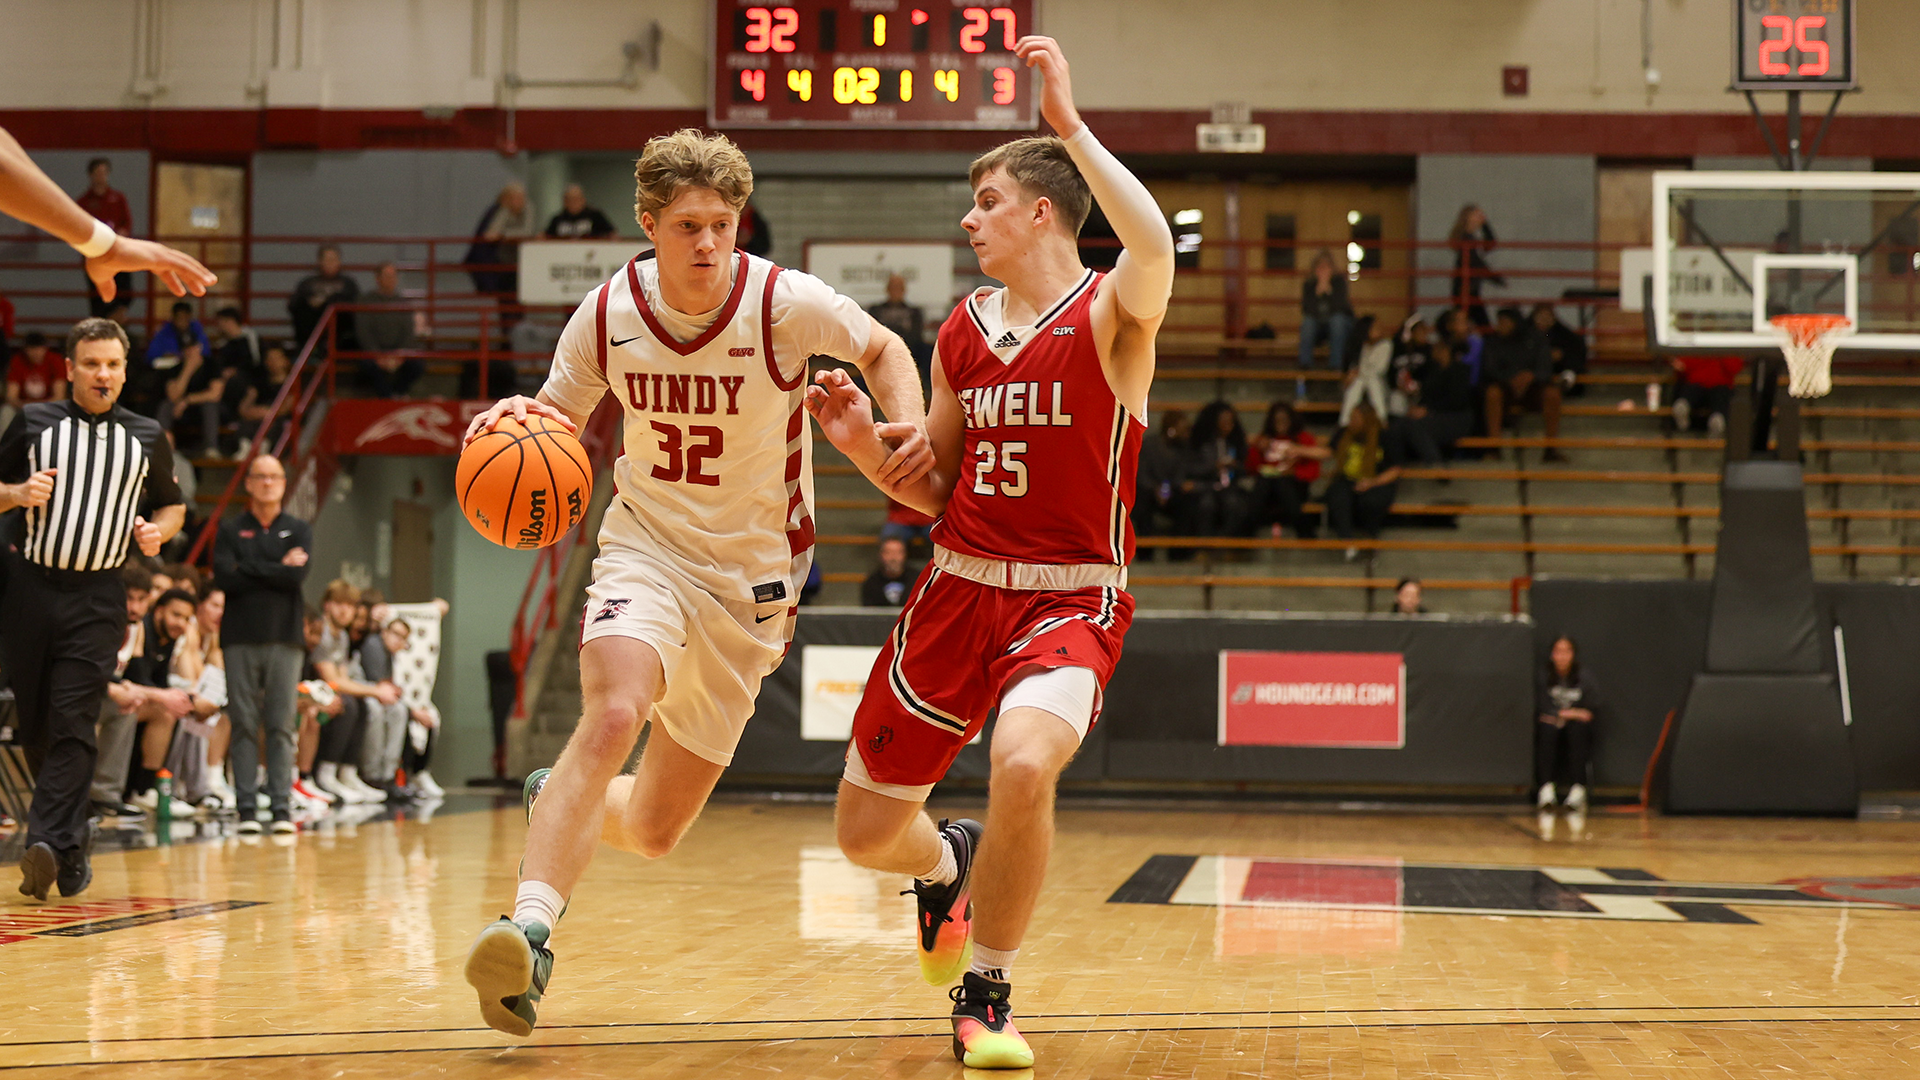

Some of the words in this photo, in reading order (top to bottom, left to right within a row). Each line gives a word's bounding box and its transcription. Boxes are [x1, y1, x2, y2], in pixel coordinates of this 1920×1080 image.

[745, 7, 799, 52] 32
[873, 13, 887, 47] 1
[959, 7, 1017, 53] 27
[1759, 15, 1830, 76] 25
[740, 69, 766, 102] 4
[787, 69, 812, 102] 4
[833, 67, 880, 104] 02
[899, 69, 913, 102] 1
[934, 69, 959, 102] 4
[992, 67, 1016, 105] 3
[994, 340, 1021, 348] adidas
[624, 372, 745, 415] UINDY
[958, 381, 1073, 429] EWELL
[649, 419, 724, 487] 32
[973, 440, 1030, 498] 25
[565, 487, 582, 532] CAA
